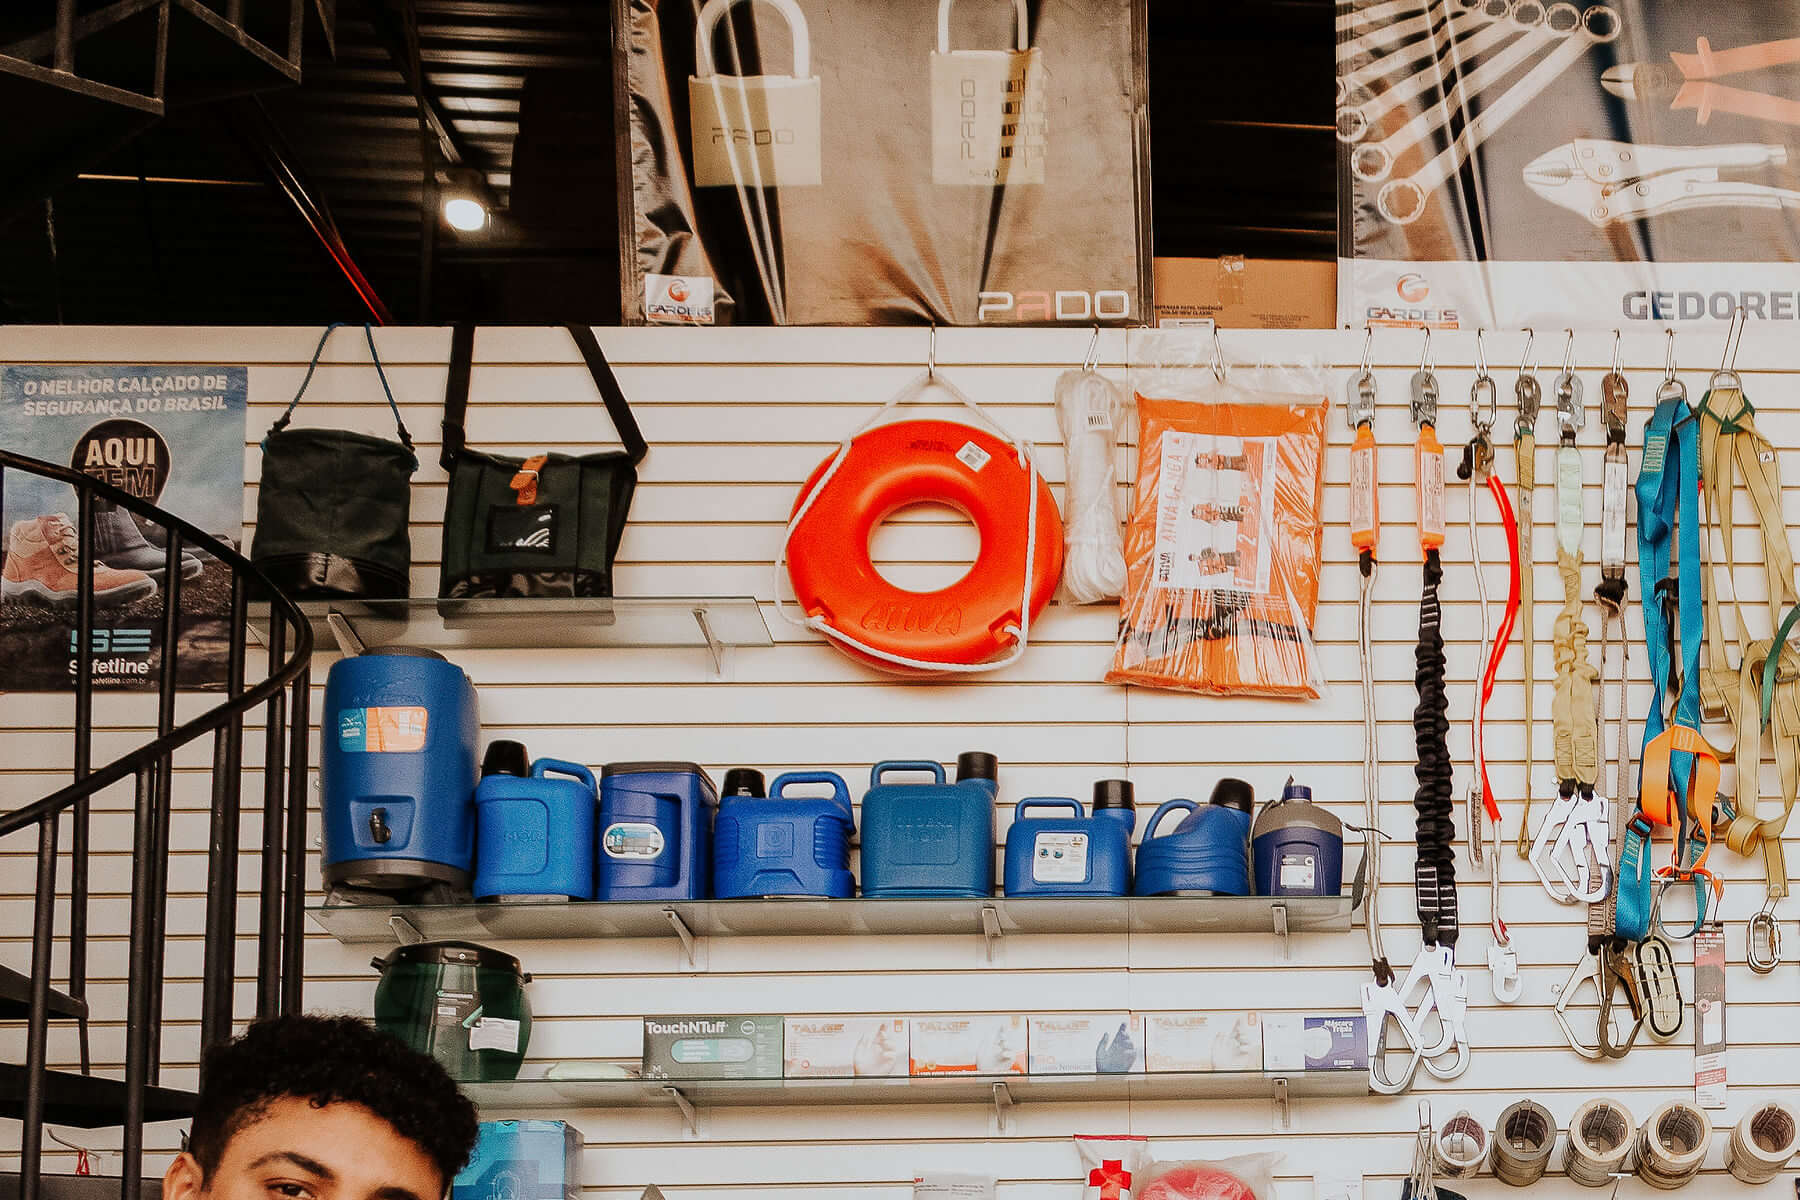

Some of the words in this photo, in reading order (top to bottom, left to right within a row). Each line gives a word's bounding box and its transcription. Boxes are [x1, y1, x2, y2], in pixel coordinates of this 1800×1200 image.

[978, 290, 1130, 321] PADO
[1622, 291, 1793, 320] GEDORE
[24, 381, 39, 395] O
[40, 378, 115, 395] MELHOR
[118, 376, 200, 397] CALÇADO
[203, 375, 228, 391] DE
[23, 398, 133, 417] SEGURANÇA
[135, 398, 161, 412] DO
[164, 395, 228, 411] BRASIL
[85, 437, 156, 467] AQUI
[68, 658, 149, 675] Sfetline
[646, 1021, 727, 1034] TouchNTuff
